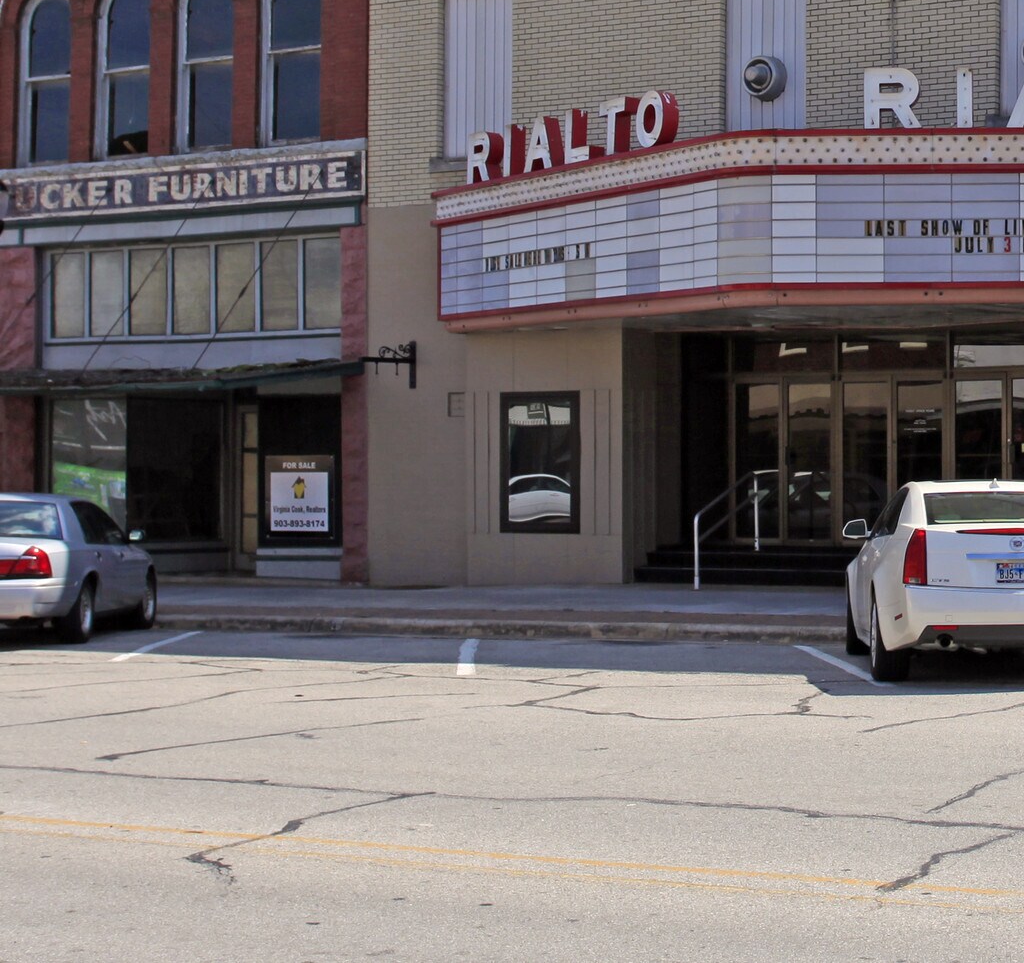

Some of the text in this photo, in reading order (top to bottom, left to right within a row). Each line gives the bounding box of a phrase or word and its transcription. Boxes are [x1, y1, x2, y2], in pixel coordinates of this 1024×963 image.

[466, 90, 679, 184] RIALTO
[148, 161, 347, 202] FURNITURE
[865, 220, 905, 236] LAST
[921, 220, 962, 236] SHOW
[973, 219, 990, 235] OF
[954, 237, 994, 253] JULY
